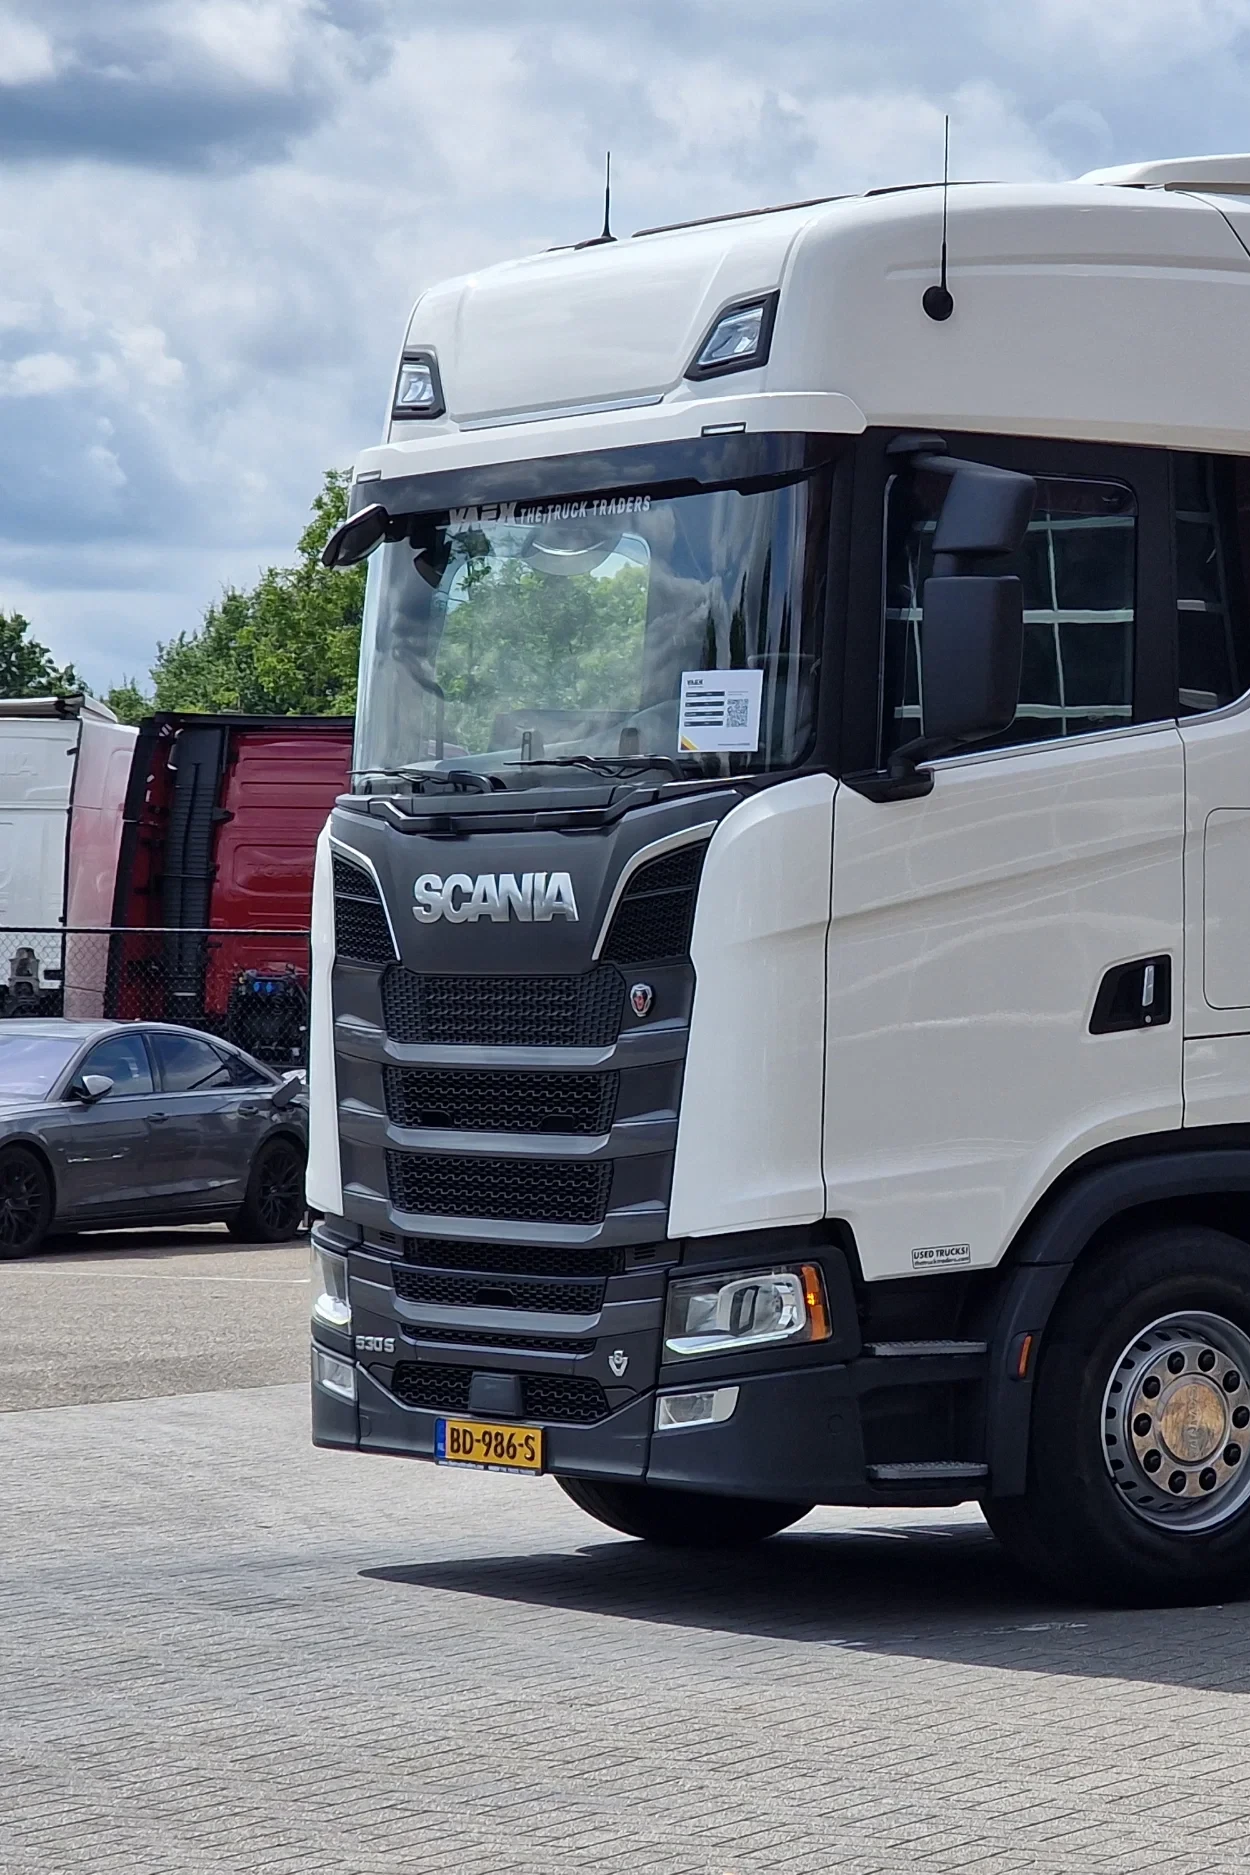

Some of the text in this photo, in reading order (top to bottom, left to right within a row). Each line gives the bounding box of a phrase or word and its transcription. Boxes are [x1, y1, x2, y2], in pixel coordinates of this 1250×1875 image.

[520, 508, 545, 524] THE
[546, 501, 587, 523] TRUCK
[593, 495, 652, 516] TRADERS
[412, 872, 580, 924] SCANIA
[913, 1247, 969, 1260] USED TRUCKS!
[449, 1427, 536, 1462] BD-986-S
